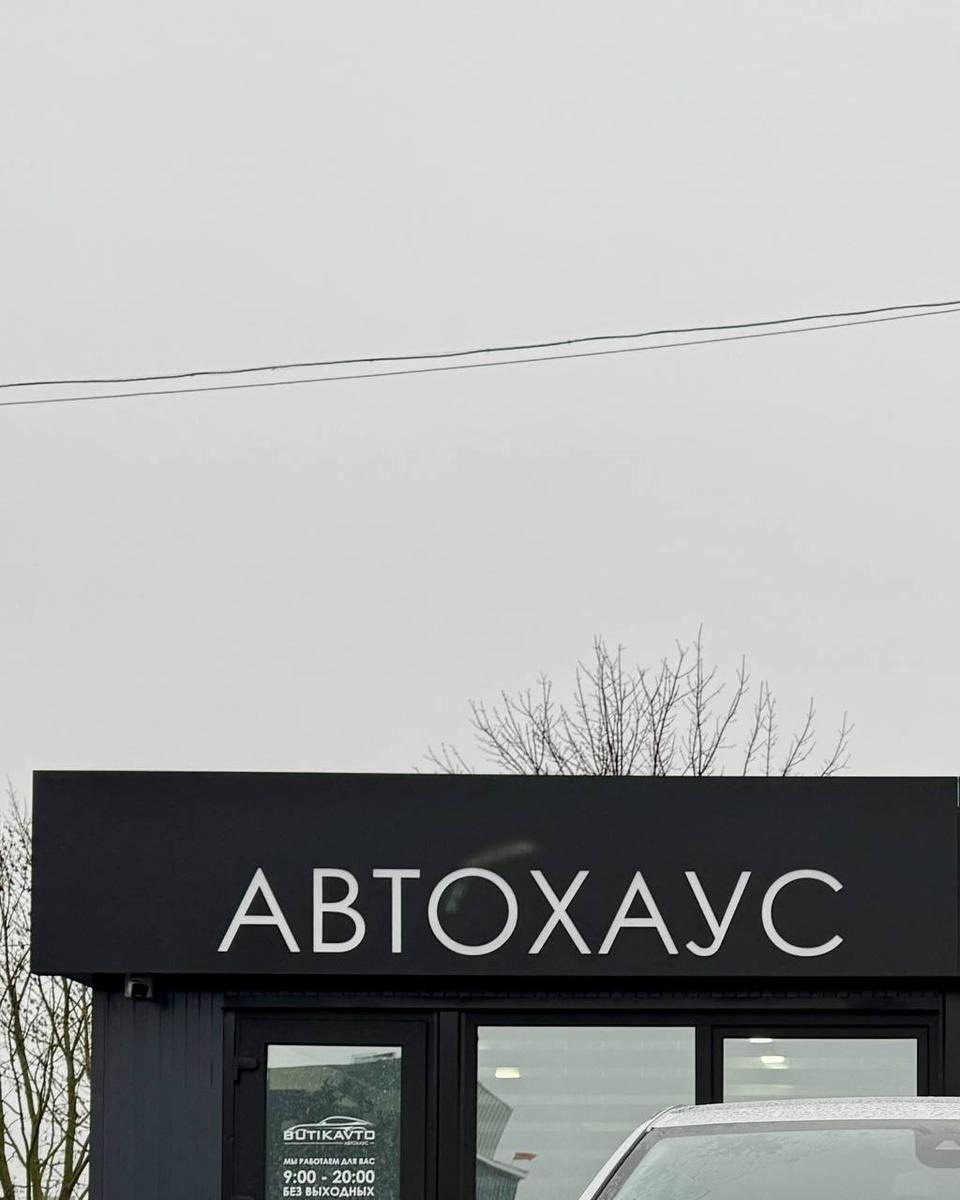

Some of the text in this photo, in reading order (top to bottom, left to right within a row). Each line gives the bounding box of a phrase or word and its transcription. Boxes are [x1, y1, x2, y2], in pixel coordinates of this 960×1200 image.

[217, 867, 844, 957] АВТОХАУС
[283, 1130, 375, 1141] BUTIKAVTO
[283, 1170, 317, 1184] 9:00
[332, 1170, 376, 1184] 20:00
[283, 1187, 375, 1197] БЕЗ ВЫХОДНЫХ
